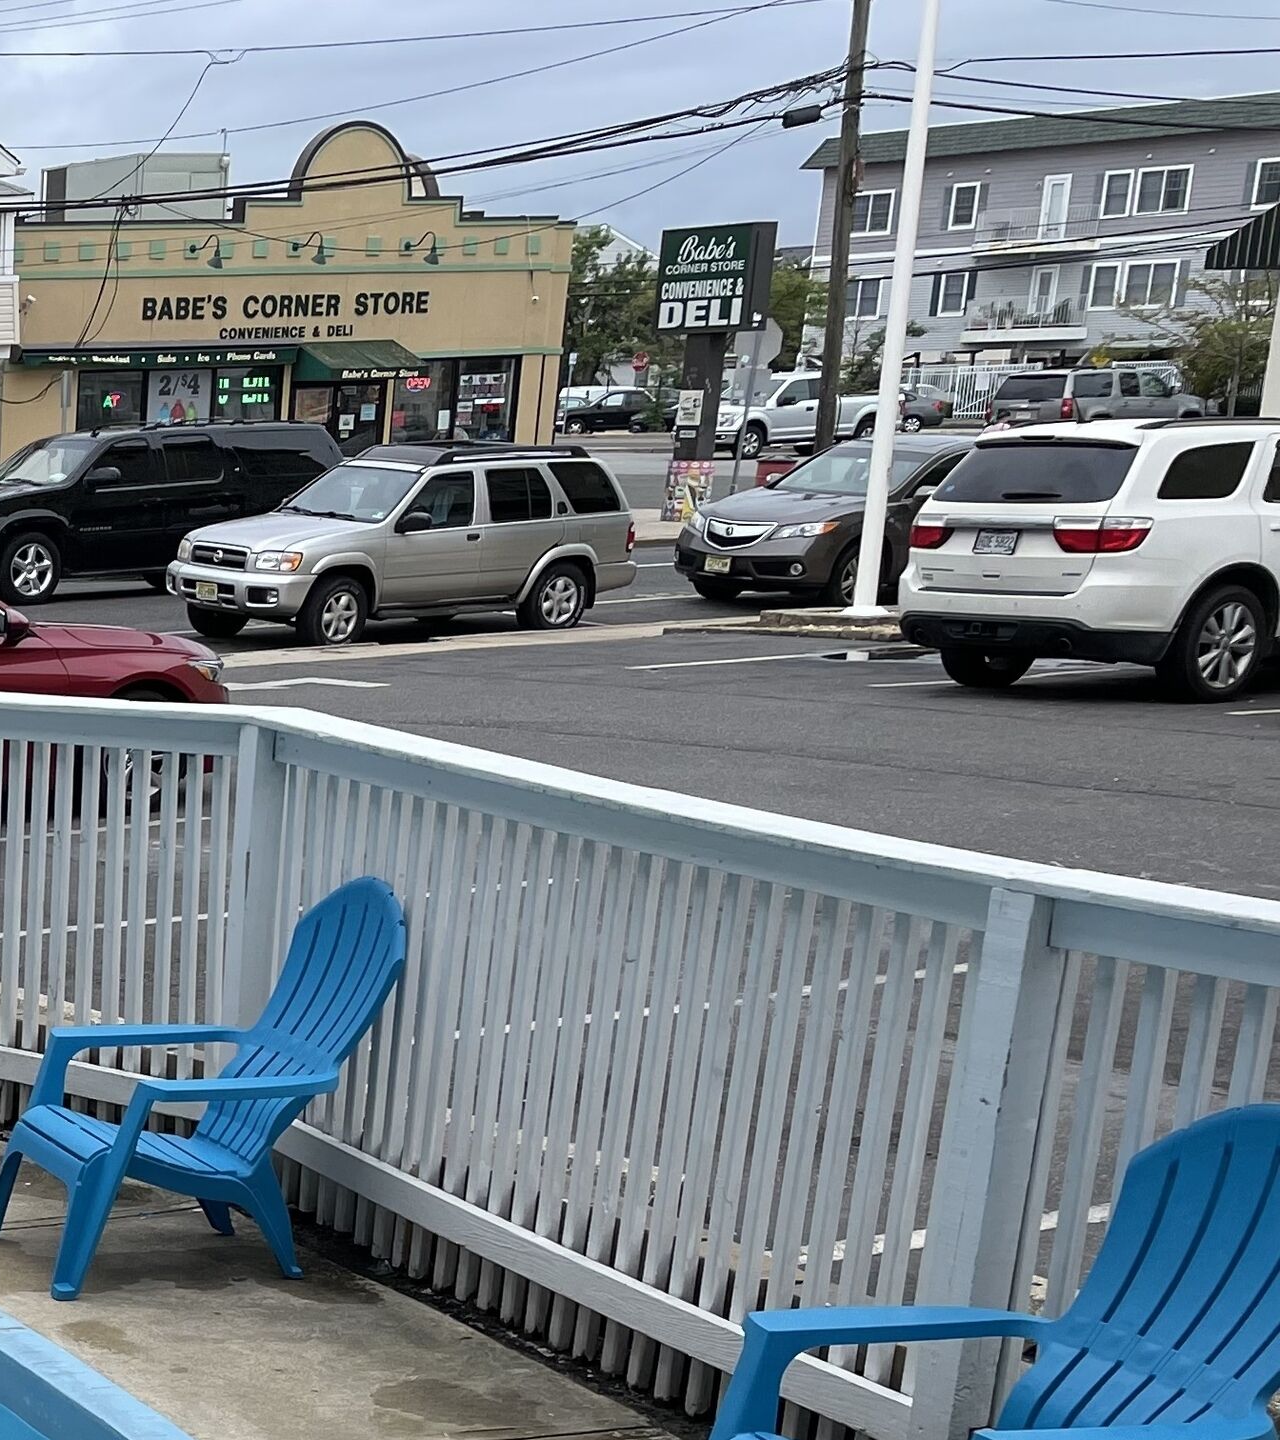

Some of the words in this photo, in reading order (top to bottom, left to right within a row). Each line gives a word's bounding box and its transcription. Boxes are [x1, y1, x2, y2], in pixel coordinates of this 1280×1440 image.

[677, 235, 737, 264] Babe's
[665, 263, 708, 275] CORNER
[710, 260, 746, 272] STORE
[661, 278, 735, 300] CONVENIENCE
[735, 277, 745, 296] &
[141, 294, 228, 321] BABE'S
[242, 293, 341, 319] CORNER
[354, 291, 430, 316] STORE
[657, 297, 743, 329] DELI
[219, 326, 306, 340] CONVENIENCE
[312, 326, 321, 338] &
[327, 324, 354, 337] DELI
[157, 354, 177, 363] Subs
[197, 353, 210, 362] Ice
[227, 352, 251, 361] Phone
[253, 351, 276, 360] Cards
[342, 370, 368, 379] Babe's
[370, 369, 397, 378] Corner
[399, 368, 419, 377] Store
[406, 377, 432, 389] OPEN
[158, 373, 200, 396] 2/$4
